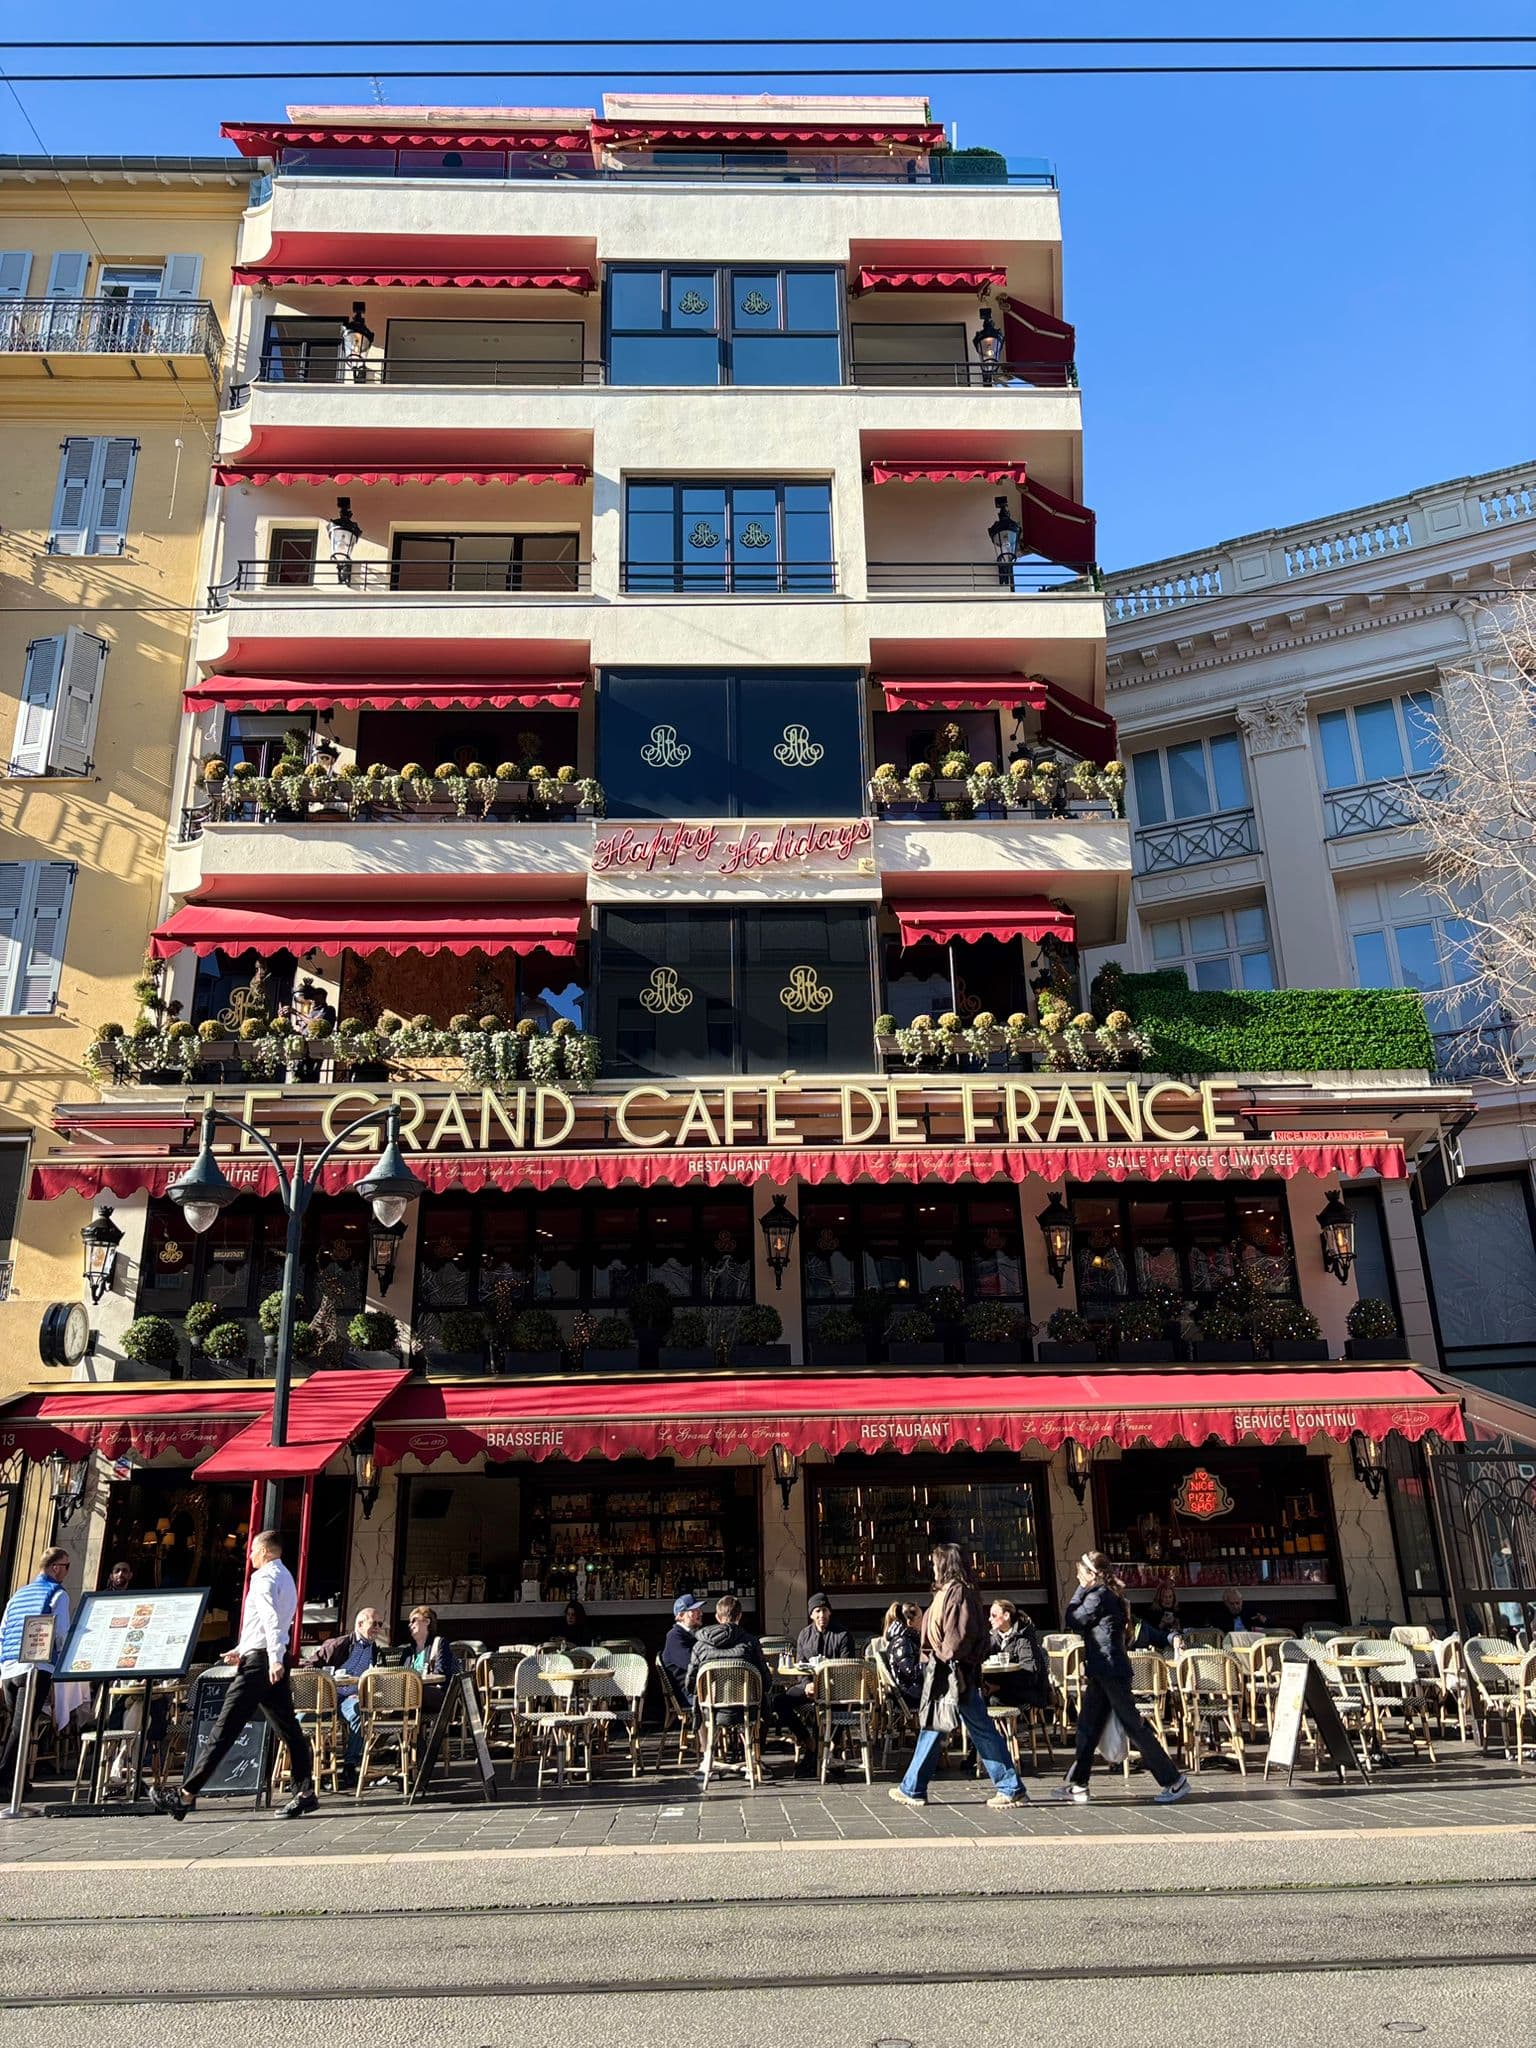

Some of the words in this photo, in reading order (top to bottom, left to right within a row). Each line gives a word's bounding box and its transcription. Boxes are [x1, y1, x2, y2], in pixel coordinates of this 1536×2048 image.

[592, 822, 719, 871] Happy
[719, 817, 872, 873] Holidays
[199, 1090, 283, 1152] LE
[321, 1088, 575, 1151] GRAND
[841, 1083, 927, 1144] DE
[961, 1080, 1244, 1144] FRANCE
[688, 1160, 770, 1172] RESTAURANT
[1107, 1155, 1147, 1168] SALLE
[1175, 1153, 1214, 1167] ÉTAGE
[1219, 1151, 1293, 1167] CLIMATISÉE
[1235, 1412, 1291, 1429] SERVICE
[1296, 1410, 1356, 1427] CONTINU
[180, 1429, 218, 1441] France
[487, 1429, 564, 1447] BRASSERIE
[659, 1429, 672, 1440] Le
[675, 1427, 712, 1442] Grand
[737, 1428, 749, 1439] de
[752, 1426, 790, 1438] France
[861, 1423, 950, 1438] RESTAURANT
[1, 1433, 16, 1446] 13
[1190, 1481, 1215, 1491] NICE
[1188, 1493, 1216, 1502] PIZZ
[1190, 1502, 1214, 1512] SHO
